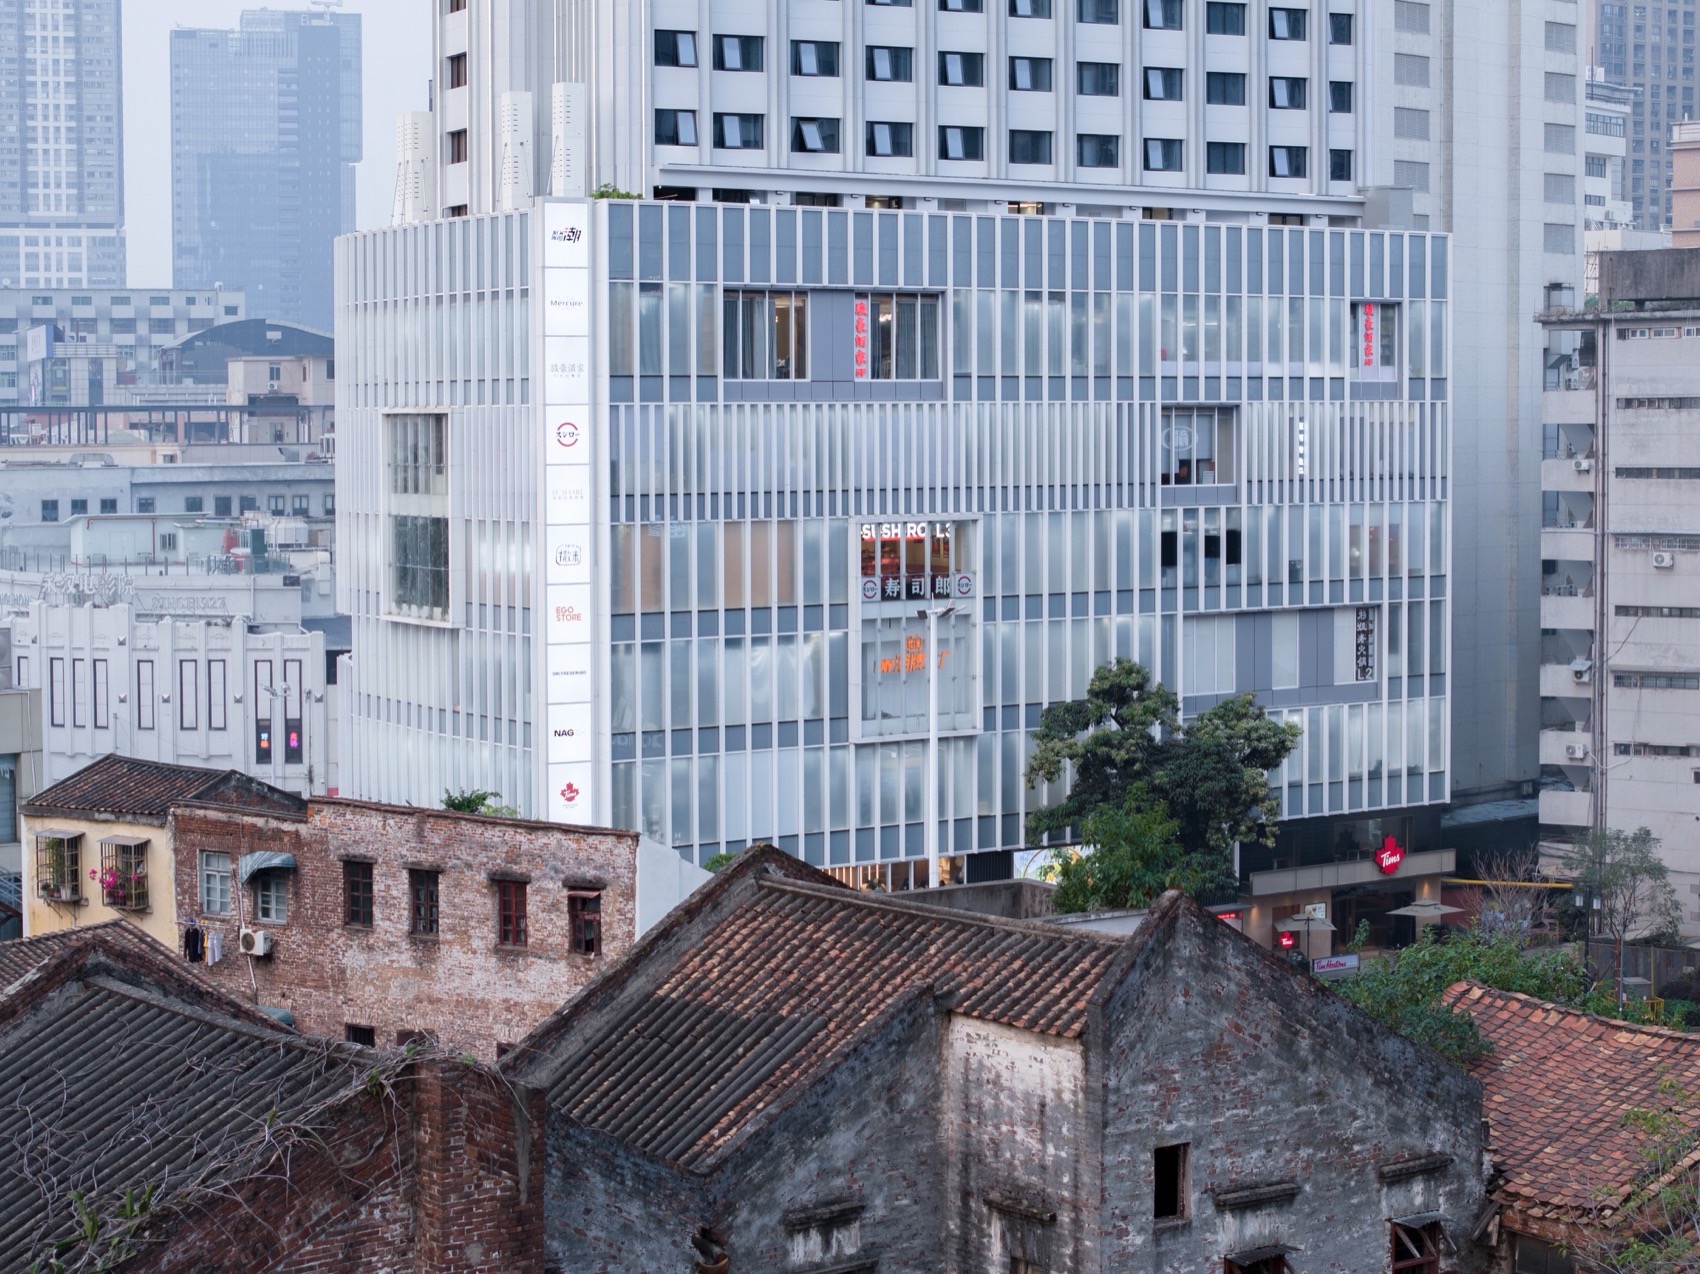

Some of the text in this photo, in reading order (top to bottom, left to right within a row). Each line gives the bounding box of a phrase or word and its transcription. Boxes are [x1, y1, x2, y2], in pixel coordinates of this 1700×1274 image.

[556, 430, 580, 438] スシロー
[862, 523, 926, 539] SSHRO
[556, 606, 574, 614] EGO
[1357, 667, 1372, 680] L2
[554, 729, 574, 737] NAG
[1381, 851, 1400, 868] Tims
[1281, 938, 1293, 946] Tims
